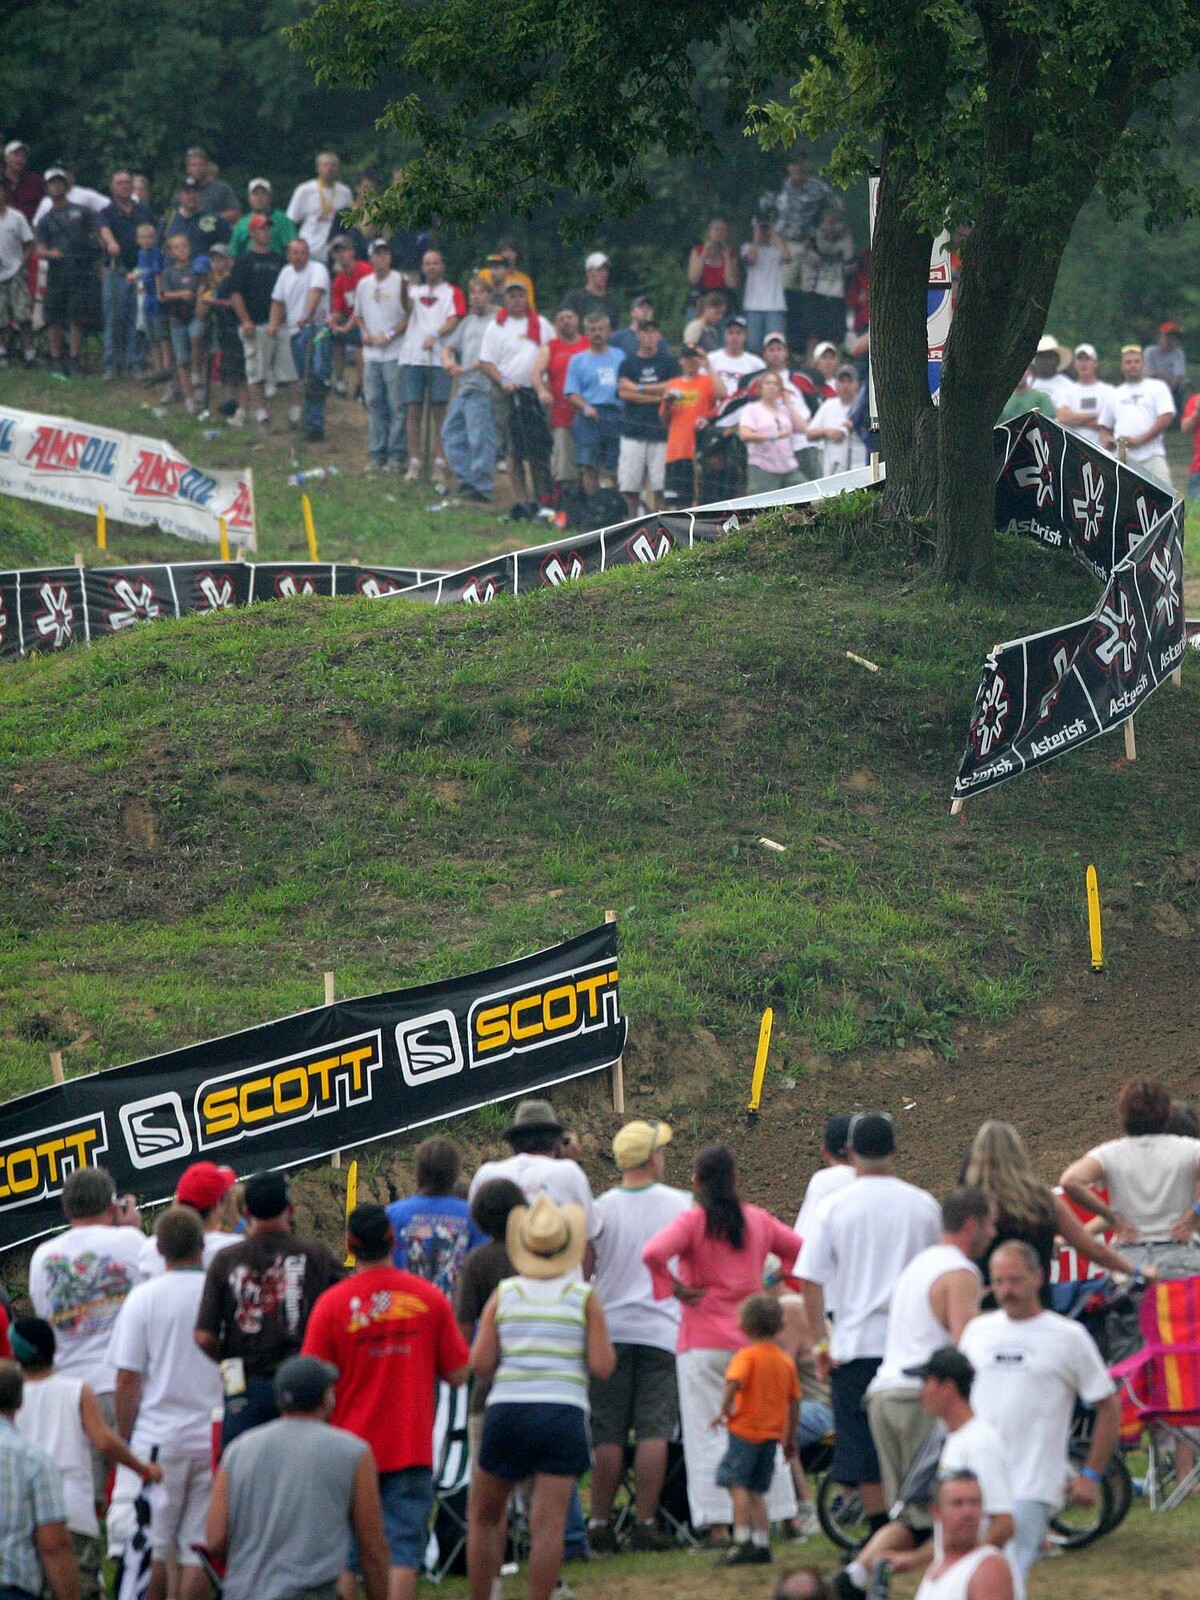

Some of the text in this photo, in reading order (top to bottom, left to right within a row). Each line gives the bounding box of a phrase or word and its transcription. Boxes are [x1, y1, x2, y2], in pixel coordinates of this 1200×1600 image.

[26, 426, 118, 476] AMSOIL
[127, 450, 217, 505] AMSOIL
[1030, 718, 1088, 759] Asterisk
[203, 1046, 372, 1136] SCOTT
